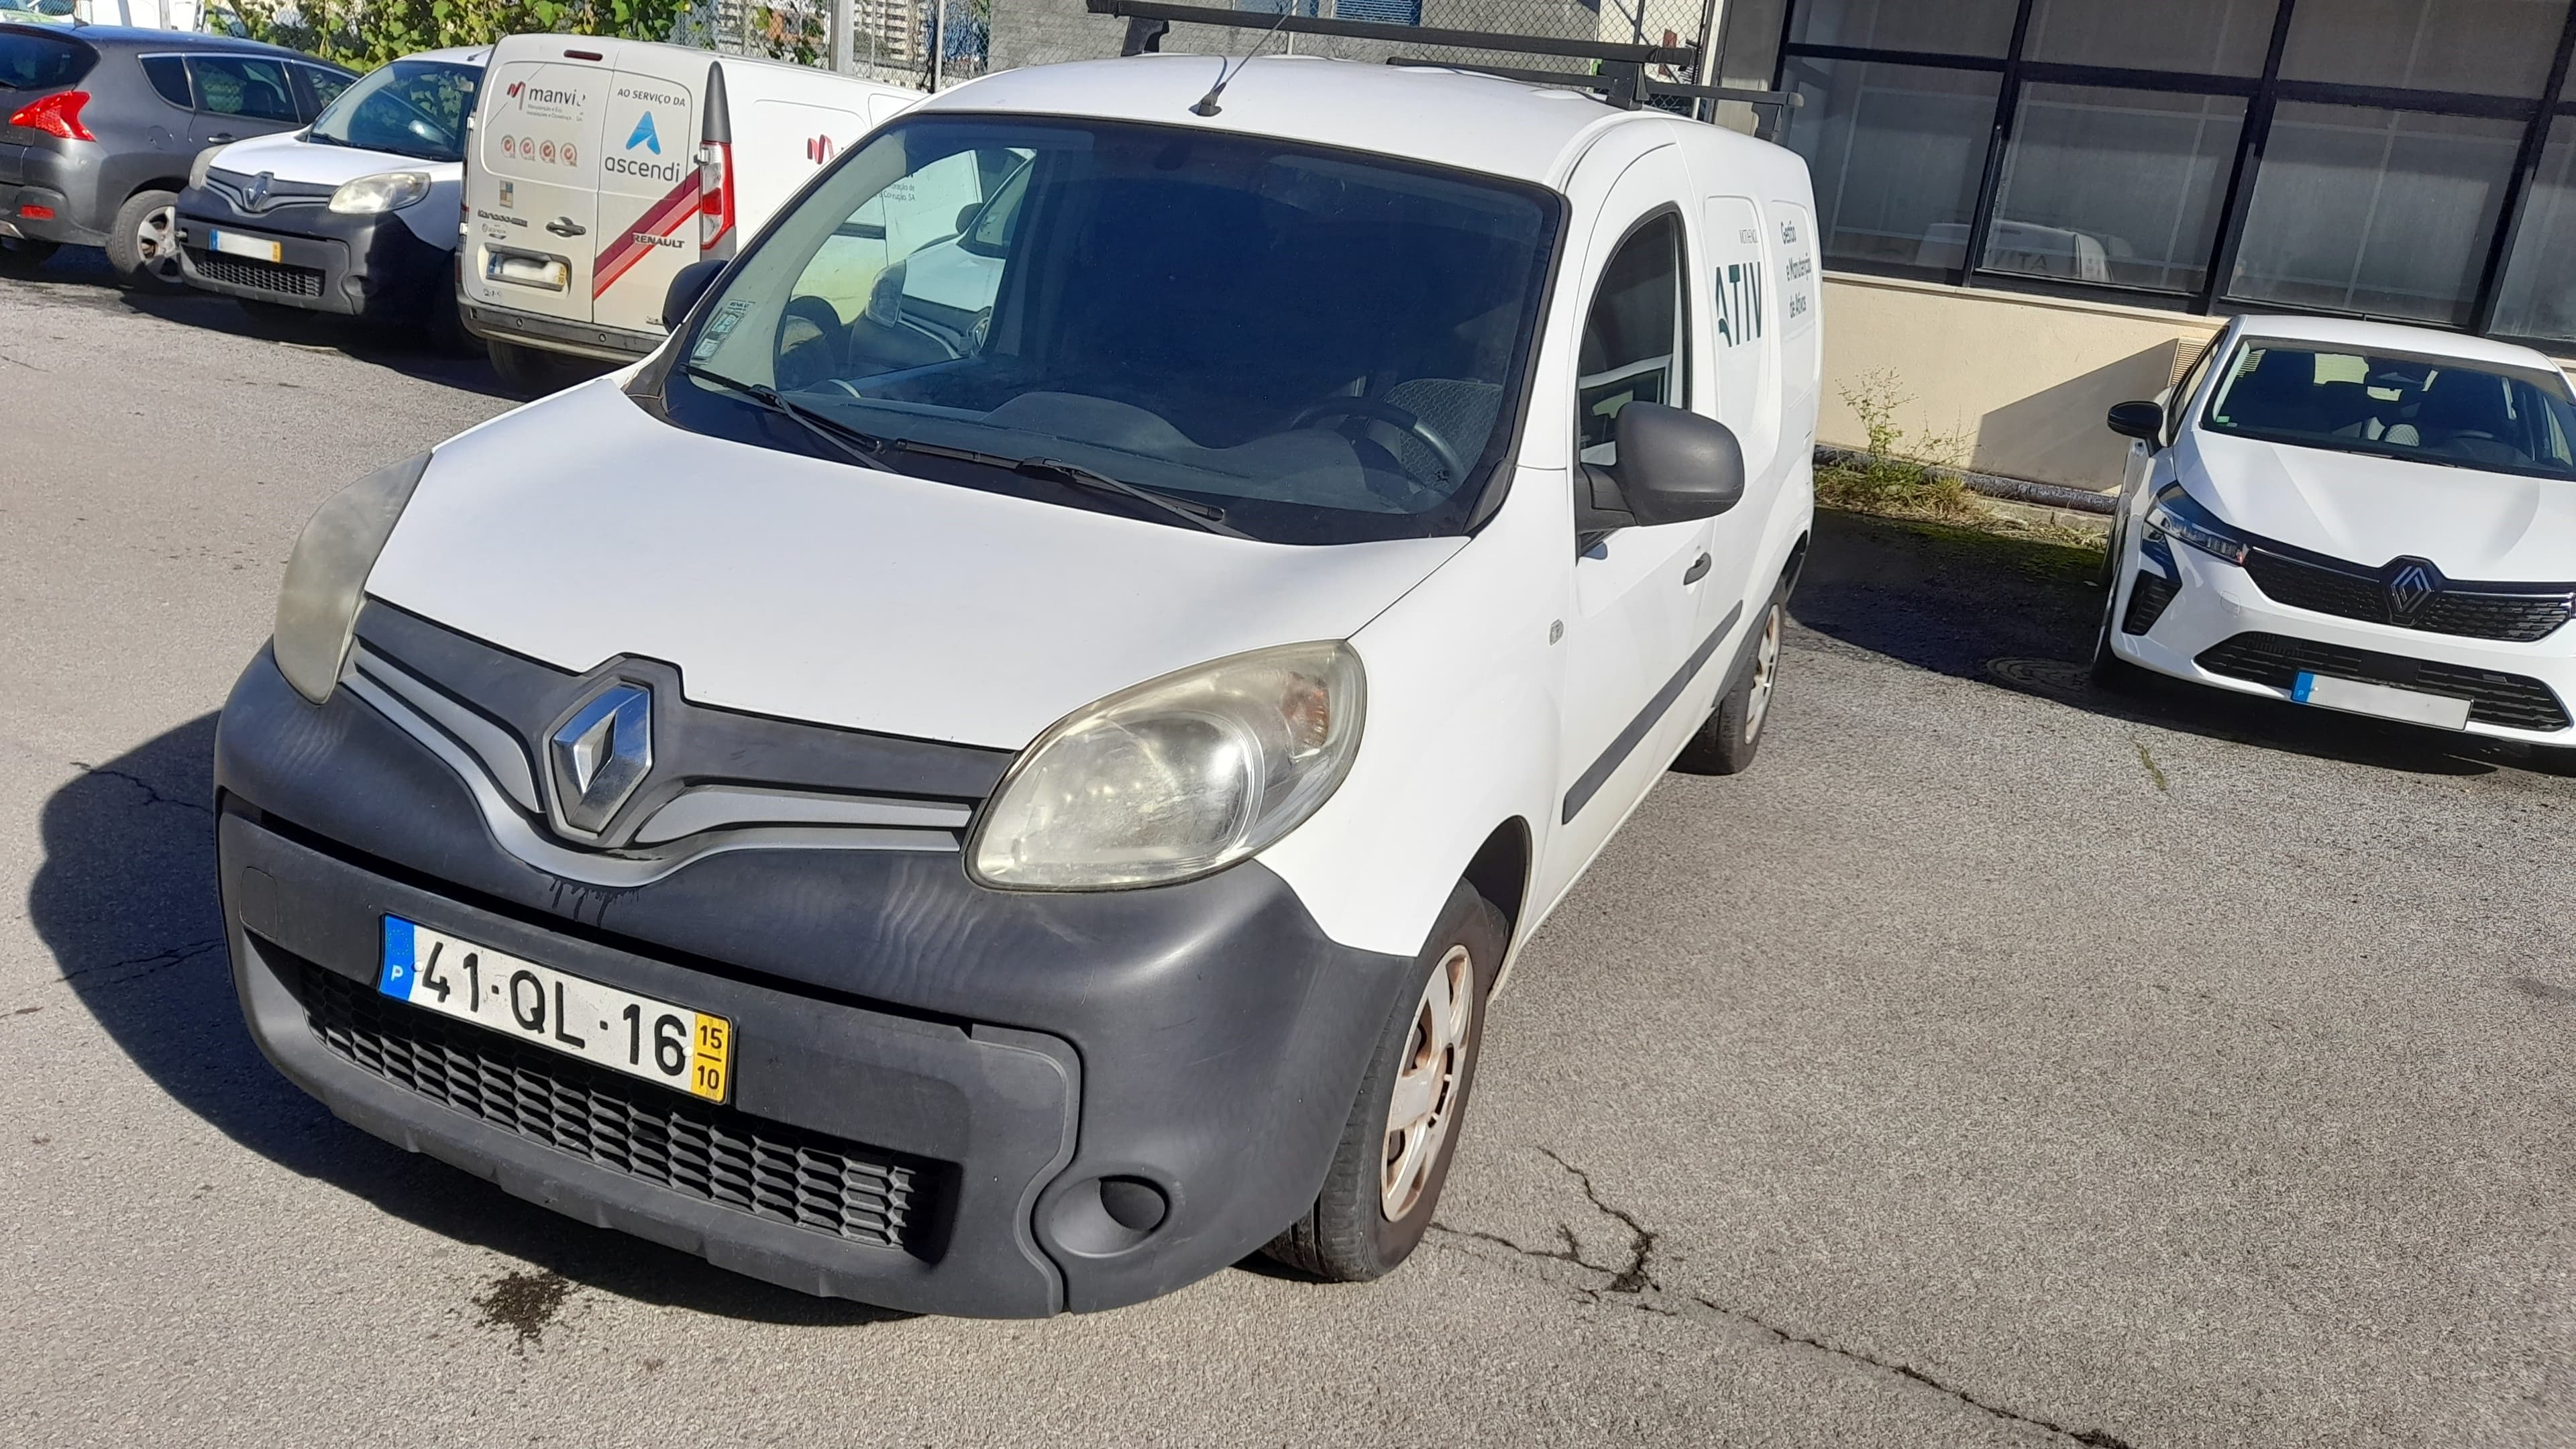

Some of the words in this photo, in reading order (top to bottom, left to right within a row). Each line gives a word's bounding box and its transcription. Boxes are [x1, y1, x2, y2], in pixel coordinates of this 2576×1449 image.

[617, 89, 631, 97] AO
[632, 90, 671, 105] SERVIÇO
[673, 97, 686, 107] DA
[604, 156, 680, 183] ascendi
[633, 234, 684, 249] RENAULT
[1715, 261, 1761, 347] ATIV
[390, 964, 403, 982] P
[700, 1025, 722, 1049] 15
[697, 1065, 719, 1089] 10
